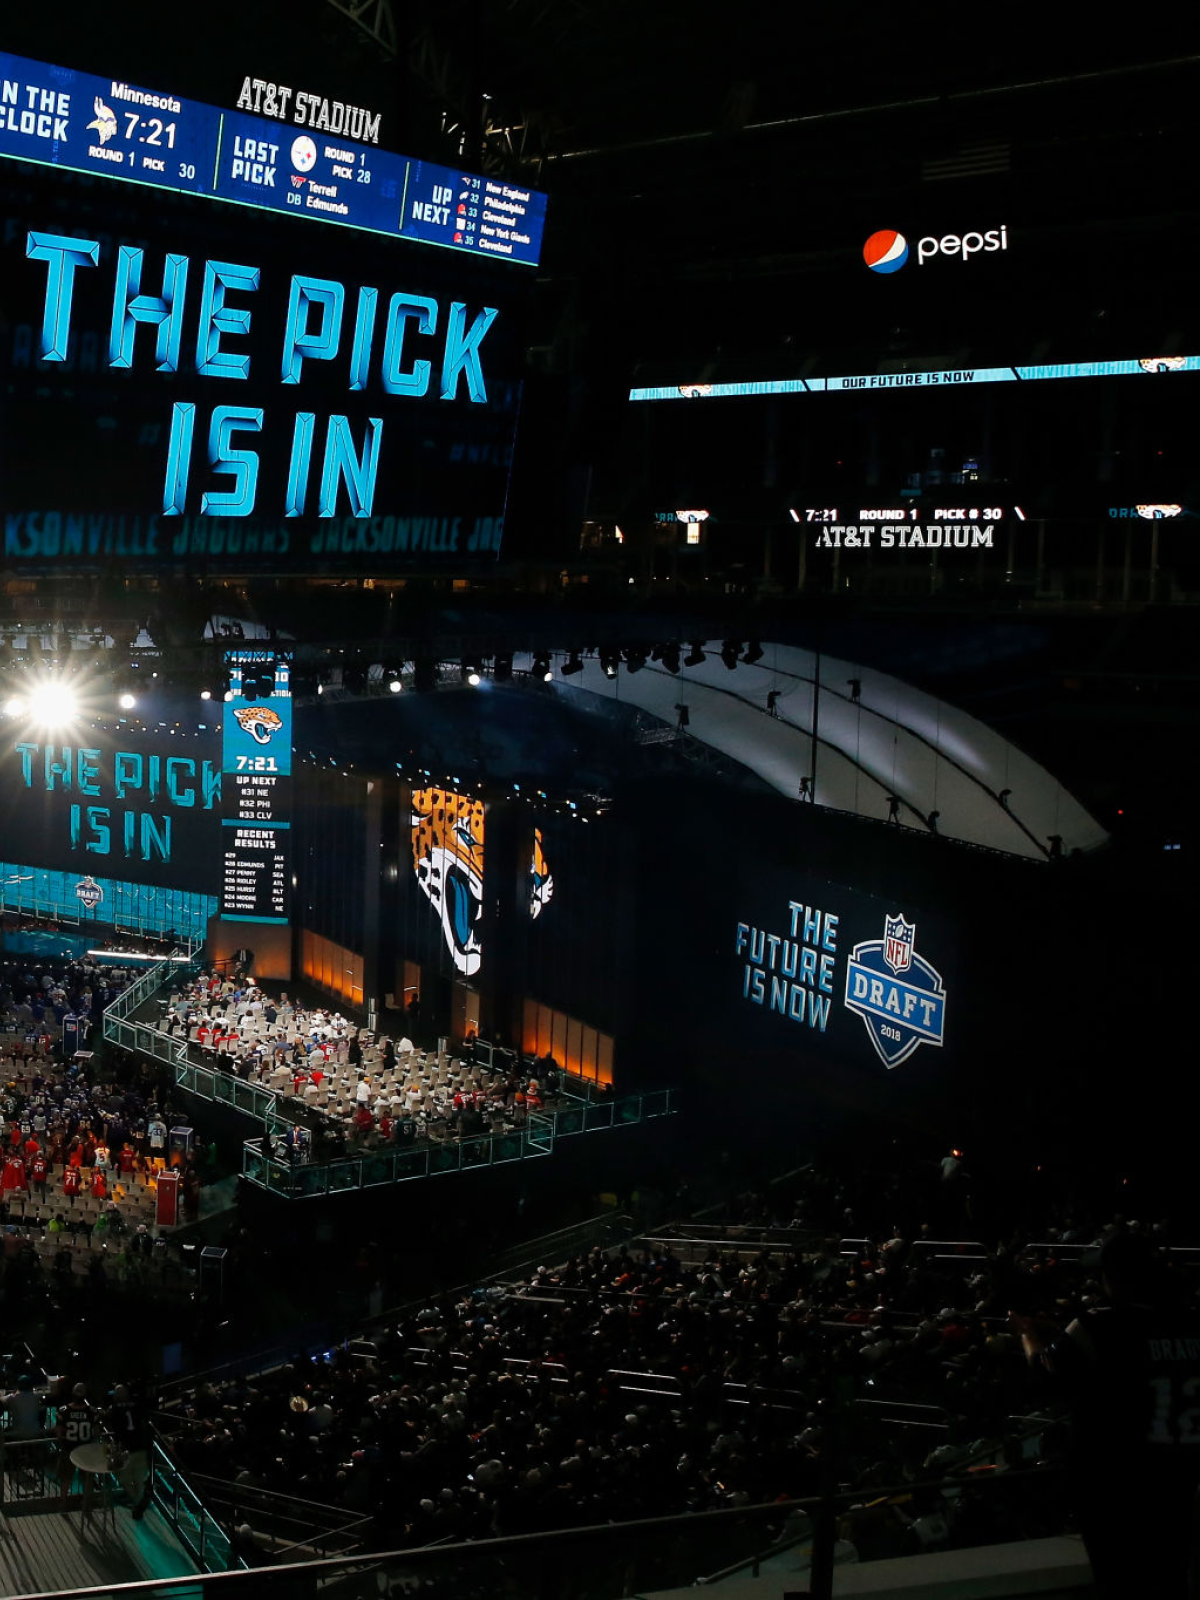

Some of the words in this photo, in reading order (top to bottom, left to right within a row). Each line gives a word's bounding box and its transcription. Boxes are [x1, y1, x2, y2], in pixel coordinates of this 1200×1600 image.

[26, 85, 71, 117] THE
[111, 81, 181, 113] Minnesota
[236, 76, 292, 120] AT&T
[294, 91, 382, 144] STADIUM
[124, 112, 176, 149] 7:21
[234, 135, 279, 165] LAST
[324, 146, 355, 163] ROUND
[359, 153, 366, 166] 1
[89, 145, 123, 163] ROUND
[128, 151, 135, 167] 1
[143, 157, 166, 172] PICK
[178, 163, 196, 180] 30
[231, 158, 277, 187] PICK
[332, 165, 353, 180] PICK
[357, 169, 371, 184] 28
[309, 180, 337, 197] Terrell
[432, 185, 453, 206] UP
[287, 192, 301, 205] DB
[306, 195, 349, 215] Edmunds
[412, 201, 451, 225] NEXT
[917, 225, 1008, 265] pepsi
[26, 231, 261, 380] THE
[280, 274, 499, 404] PICK
[842, 377, 867, 389] OUR
[870, 373, 924, 387] FUTURE
[926, 372, 940, 385] IS
[943, 370, 975, 383] NOW
[162, 401, 265, 518] IS
[285, 412, 384, 519] IN
[859, 509, 904, 520] ROUND
[910, 508, 917, 520] 1
[935, 509, 965, 520] PICK
[983, 508, 1002, 520] 30
[880, 525, 994, 547] STADIUM
[235, 756, 278, 771] 7:21
[14, 742, 101, 797] THE
[115, 752, 222, 810] PICK
[236, 776, 250, 785] UP
[251, 776, 276, 786] NEXT
[257, 789, 269, 797] NE
[257, 800, 271, 808] PHI
[256, 812, 272, 820] CLV
[70, 803, 111, 854] IS
[124, 810, 171, 863] IN
[234, 839, 276, 849] RESULTS
[237, 829, 275, 839] RECENT
[788, 900, 840, 953] THE
[736, 921, 836, 994] FUTURE
[886, 937, 909, 966] NFL
[743, 965, 766, 1004] IS
[770, 976, 831, 1033] NOW
[853, 972, 936, 1027] DRAFT
[880, 1024, 901, 1042] 2018
[65, 1421, 92, 1442] 20
